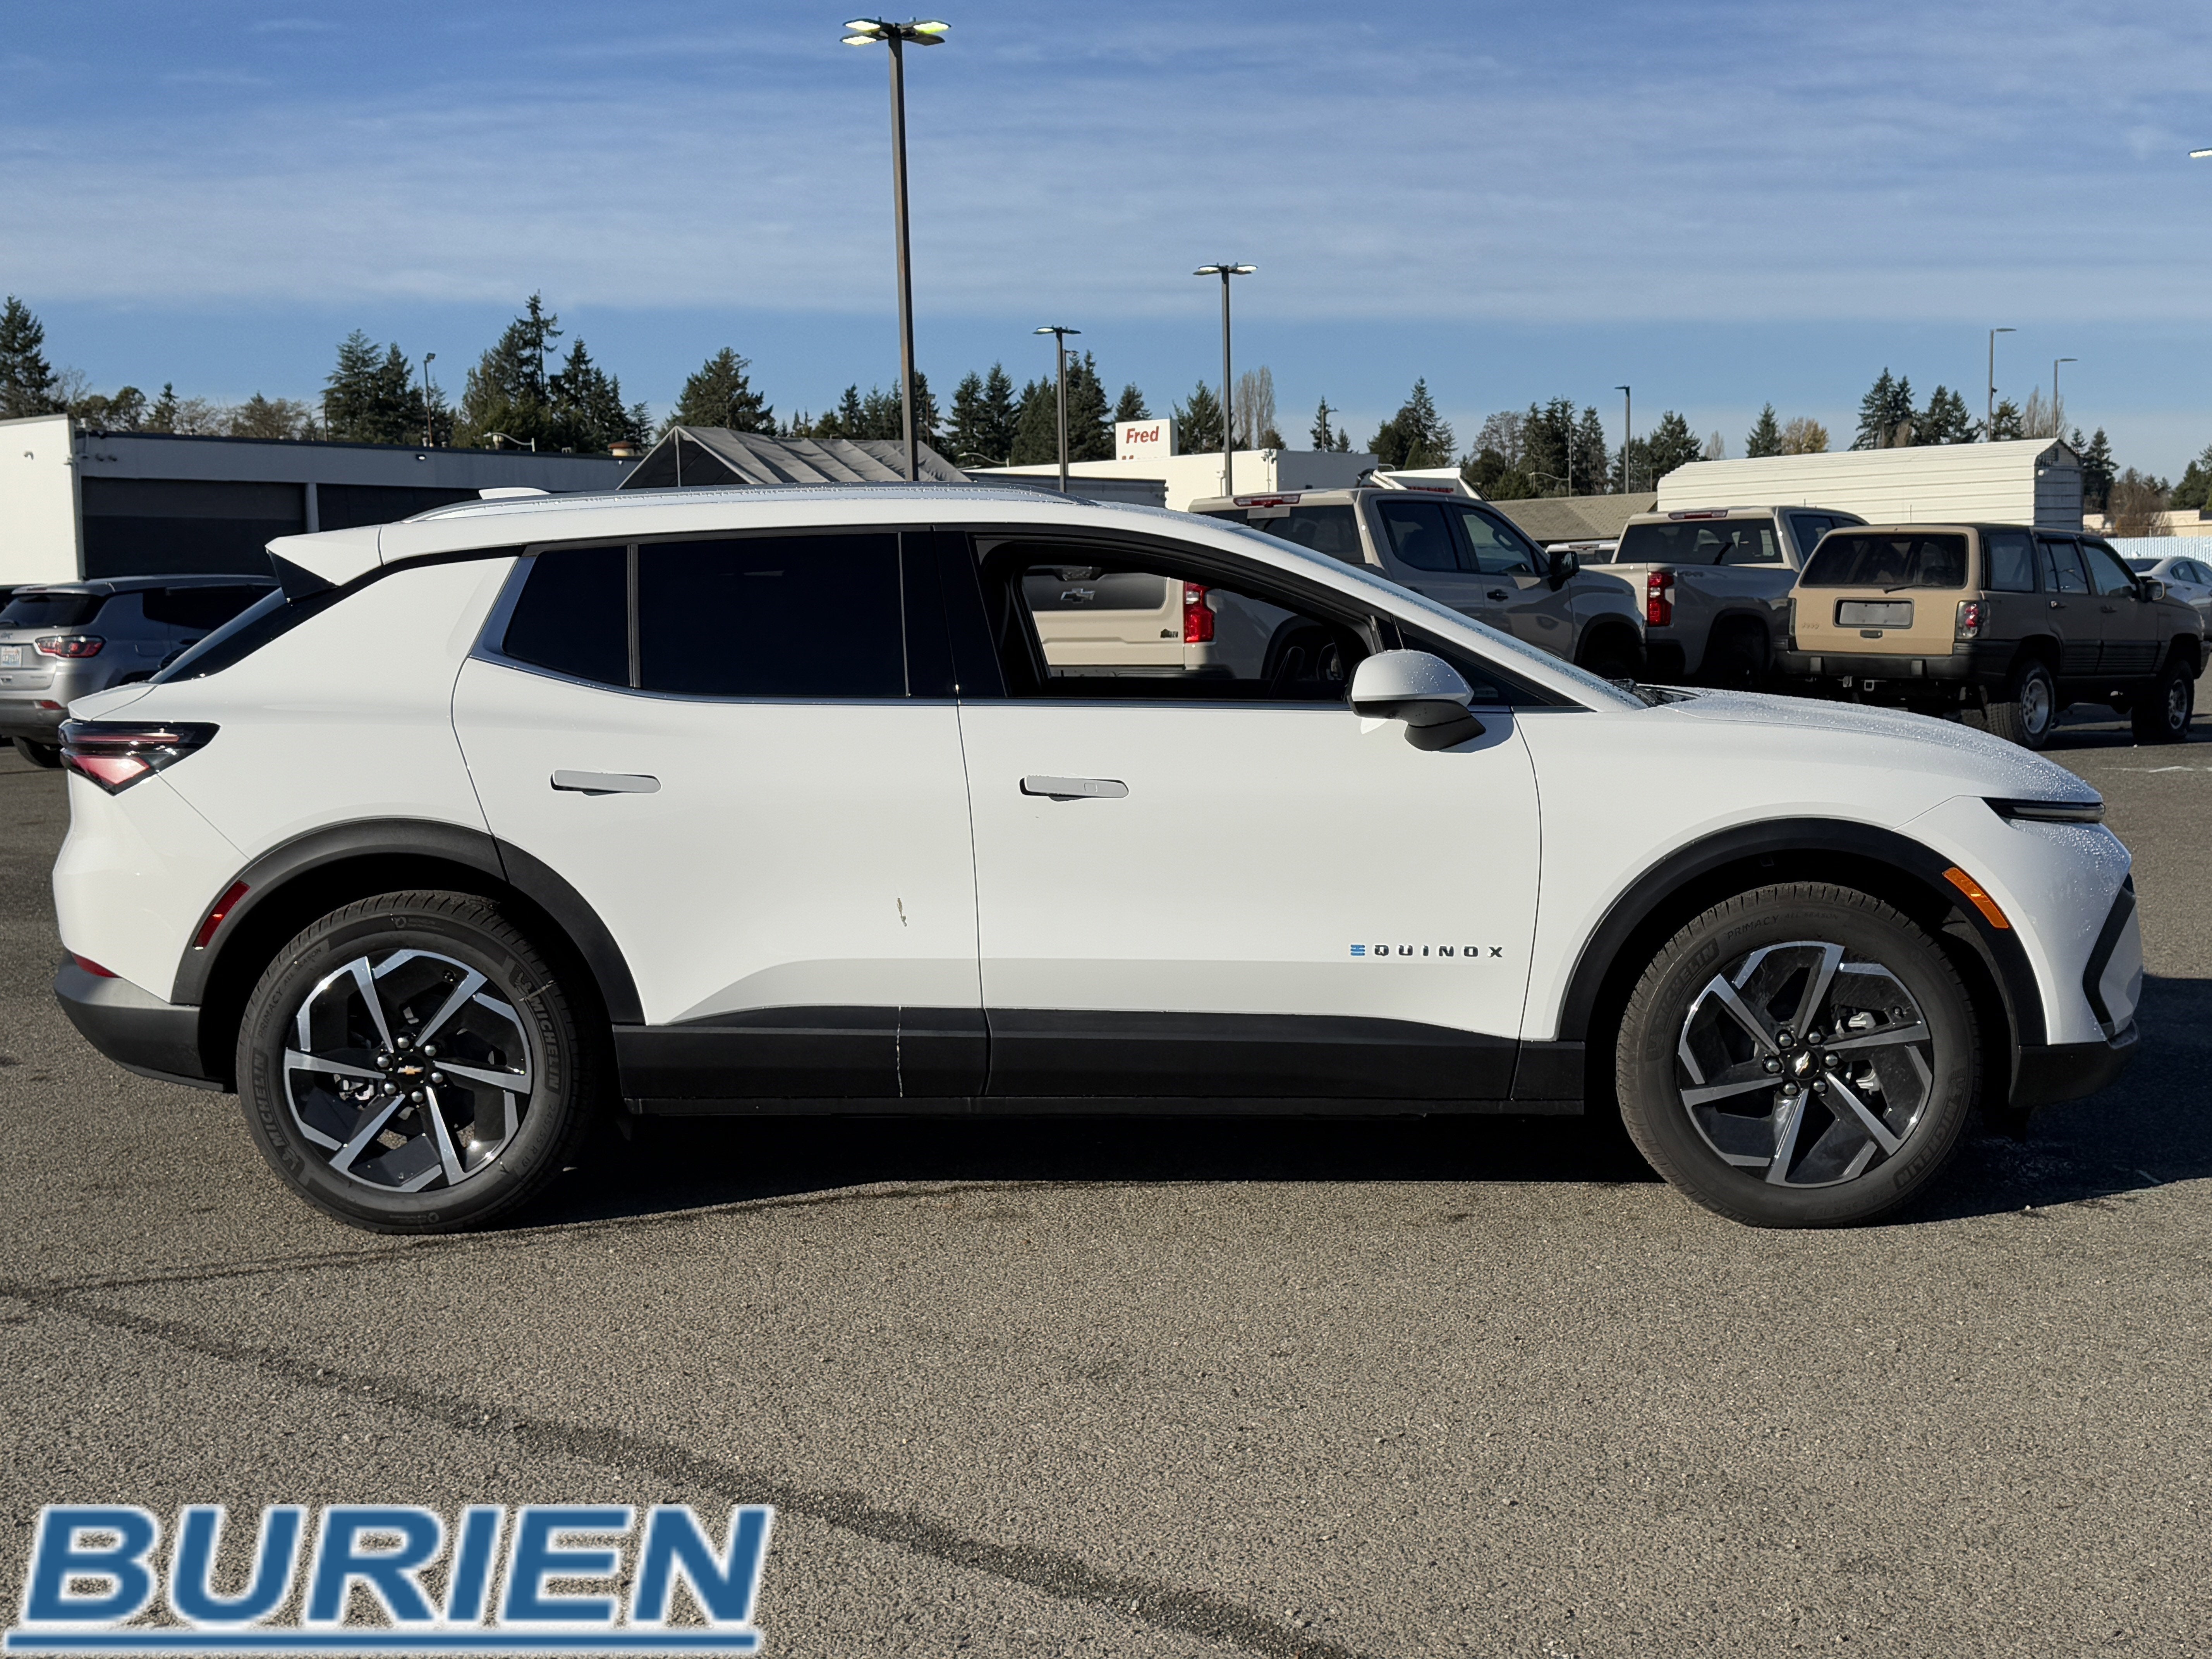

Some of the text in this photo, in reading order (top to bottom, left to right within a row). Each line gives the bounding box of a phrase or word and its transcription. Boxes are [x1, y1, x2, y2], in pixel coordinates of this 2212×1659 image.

[1126, 426, 1159, 444] Fred
[1728, 914, 1779, 940] PRIMACY
[259, 988, 283, 1039] PRIMACY
[283, 973, 295, 990] ALL
[1653, 943, 1714, 1024] MICHELIN
[530, 996, 560, 1090] MICHELIN
[253, 1054, 284, 1147] MICHELIN
[538, 1104, 556, 1144] 245/55
[522, 1155, 531, 1167] 19
[1898, 1101, 1958, 1186] MICHELIN
